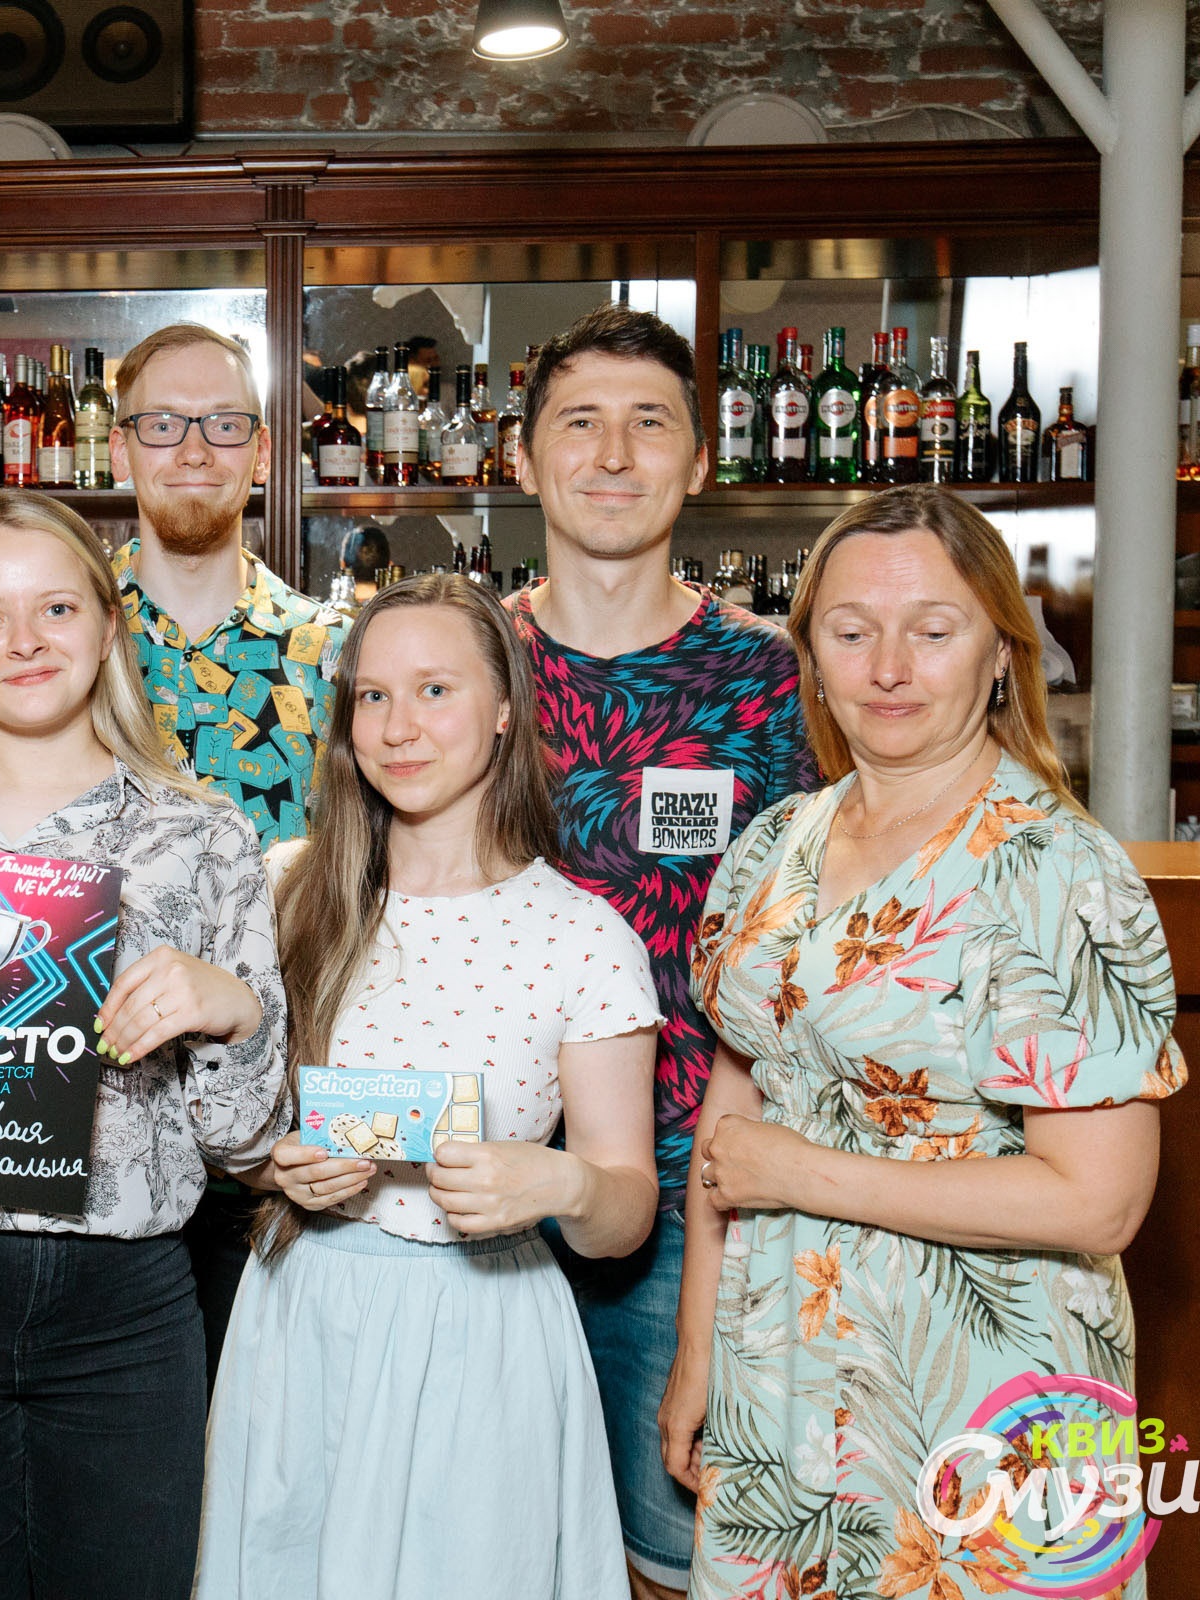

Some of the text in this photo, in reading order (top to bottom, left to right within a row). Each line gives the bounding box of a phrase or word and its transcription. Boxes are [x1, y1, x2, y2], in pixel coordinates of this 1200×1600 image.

[651, 791, 718, 816] CRAZY
[652, 817, 718, 826] LUNATIC
[652, 827, 717, 849] BONKERS
[63, 863, 111, 885] ЛАЙТ
[13, 877, 54, 897] NEW
[304, 1071, 421, 1101] Schogetten
